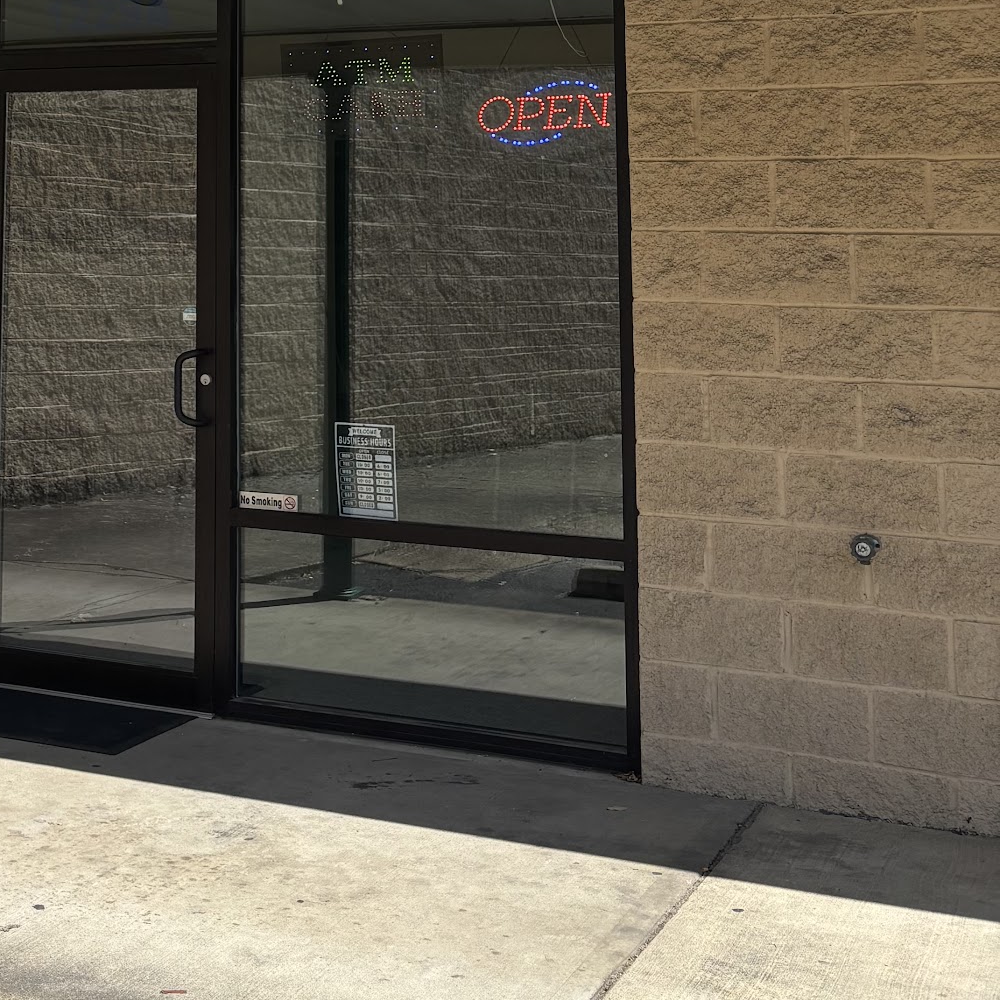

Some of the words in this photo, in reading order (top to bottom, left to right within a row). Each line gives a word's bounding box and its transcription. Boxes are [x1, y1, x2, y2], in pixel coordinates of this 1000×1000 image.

[311, 56, 415, 88] ATM
[306, 90, 426, 121] CASH
[477, 92, 613, 133] OPEN
[339, 436, 368, 446] BUSINESS
[370, 438, 392, 448] HOURS
[352, 427, 377, 435] WELCOME
[240, 495, 250, 504] No
[251, 495, 282, 509] Smoking
